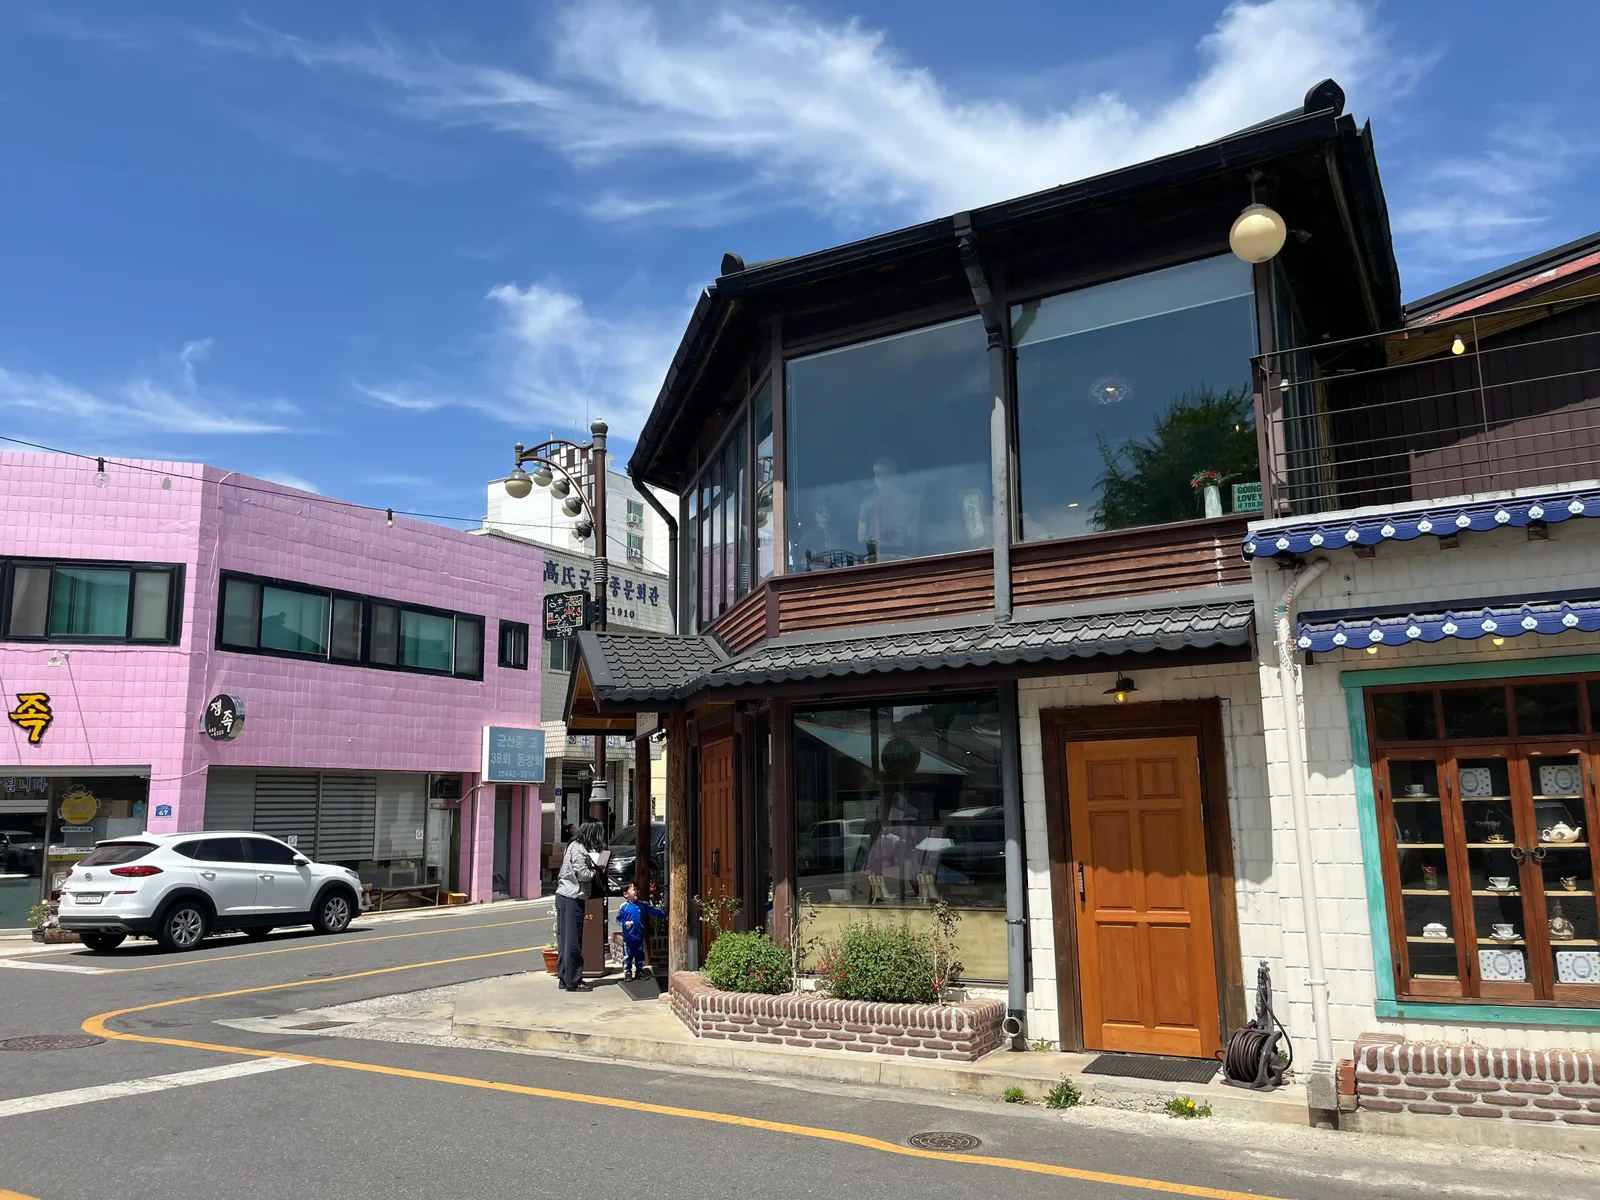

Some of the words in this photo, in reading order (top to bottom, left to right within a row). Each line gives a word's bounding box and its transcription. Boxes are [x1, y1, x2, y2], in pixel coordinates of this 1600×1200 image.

[1238, 485, 1262, 494] GOING
[1238, 494, 1257, 502] LOVE
[543, 560, 660, 606] 高氏군종문회관
[9, 693, 54, 745] 족
[491, 752, 511, 766] 38회
[517, 753, 543, 768] 동창회
[0, 776, 48, 792] 됩니다
